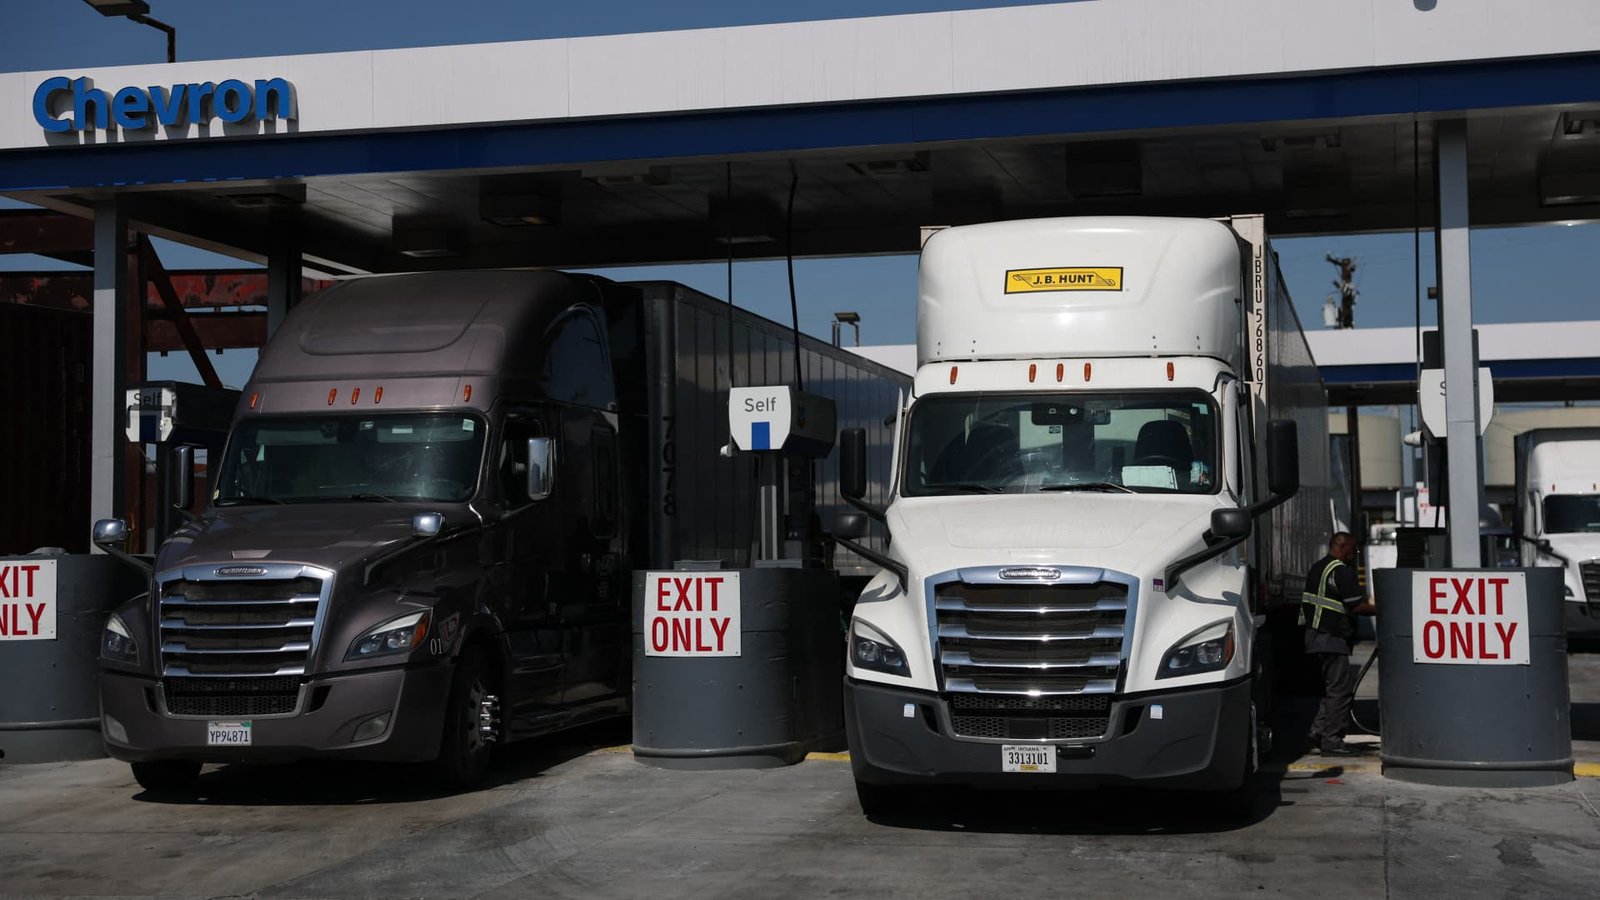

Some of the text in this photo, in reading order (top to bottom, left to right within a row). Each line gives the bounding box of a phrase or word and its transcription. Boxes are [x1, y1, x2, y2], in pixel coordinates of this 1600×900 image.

[33, 76, 290, 132] Chevron
[1033, 274, 1094, 284] J. B. HUNT
[134, 391, 161, 405] Self
[744, 396, 776, 412] Self
[663, 416, 676, 516] 7078
[0, 565, 40, 598] XIT
[657, 577, 724, 611] EXIT
[1429, 577, 1509, 615] EXIT
[0, 603, 46, 635] LY
[652, 616, 731, 652] ONLY
[430, 638, 443, 655] 01
[1423, 620, 1518, 659] ONLY
[210, 730, 249, 743] YP94871
[1008, 752, 1048, 765] 3313101
